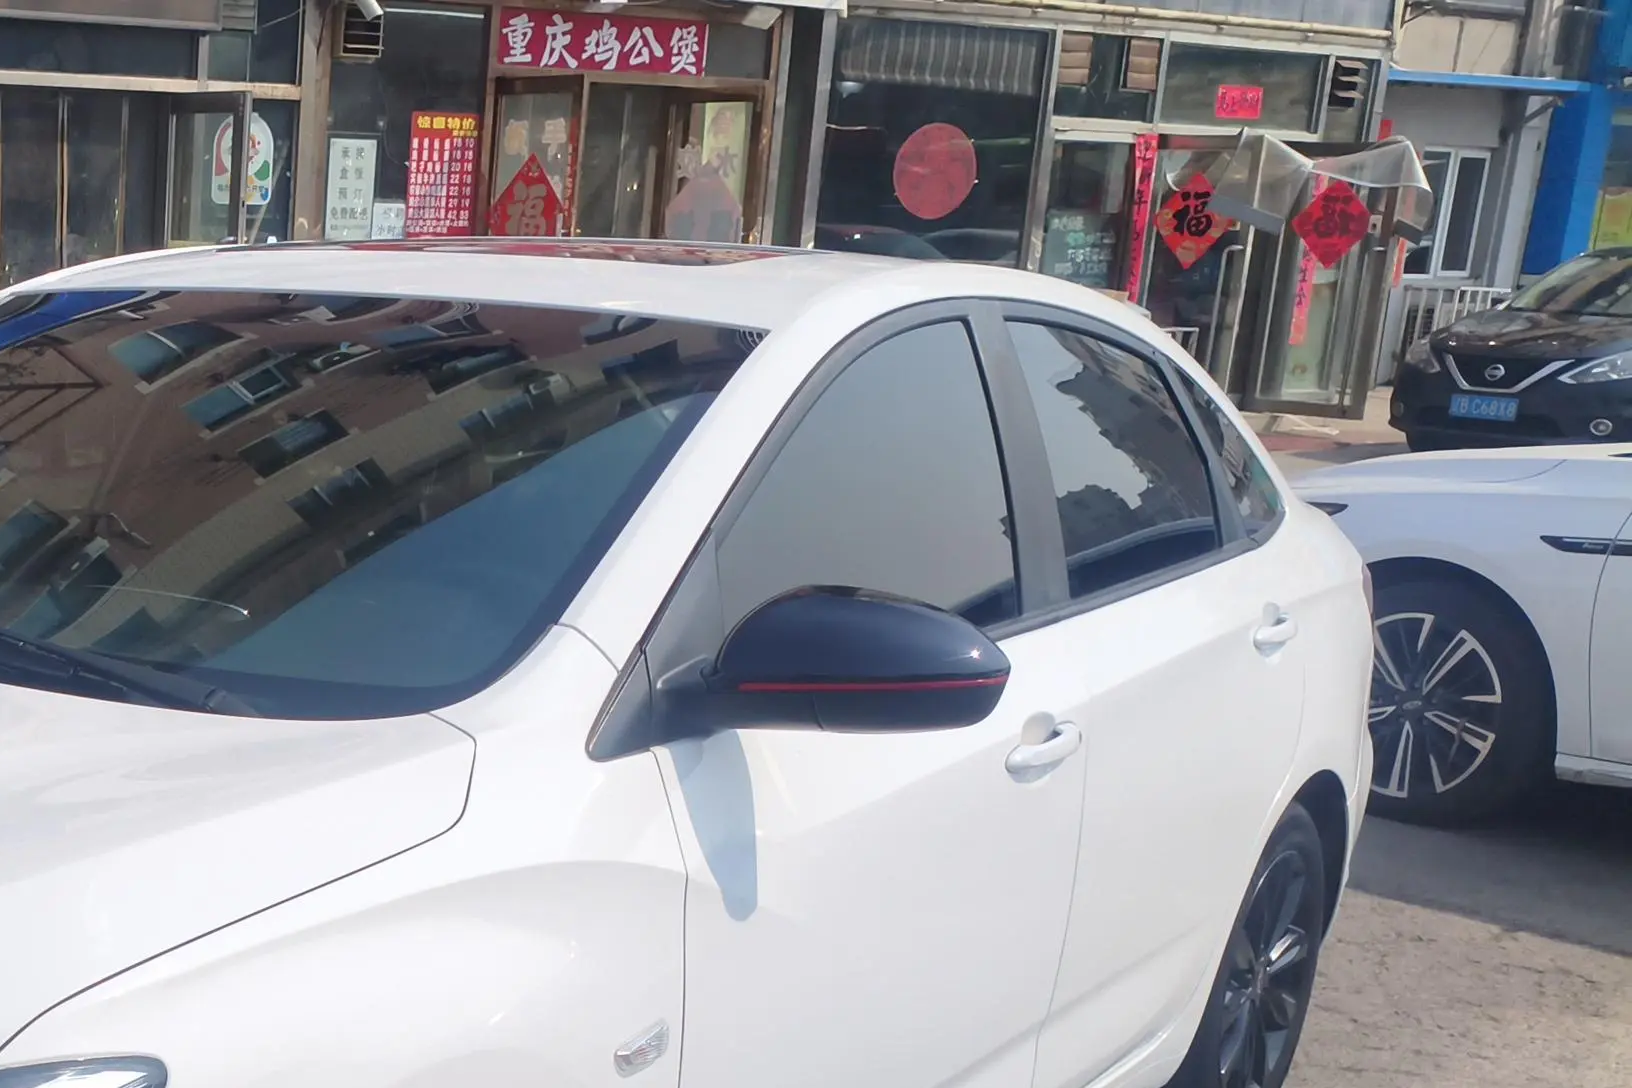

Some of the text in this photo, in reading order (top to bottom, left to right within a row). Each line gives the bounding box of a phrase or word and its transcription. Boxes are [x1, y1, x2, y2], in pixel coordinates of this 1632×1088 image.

[501, 13, 700, 75] 重庆鸡公煲
[505, 180, 548, 237] 福
[1172, 191, 1213, 236] 福
